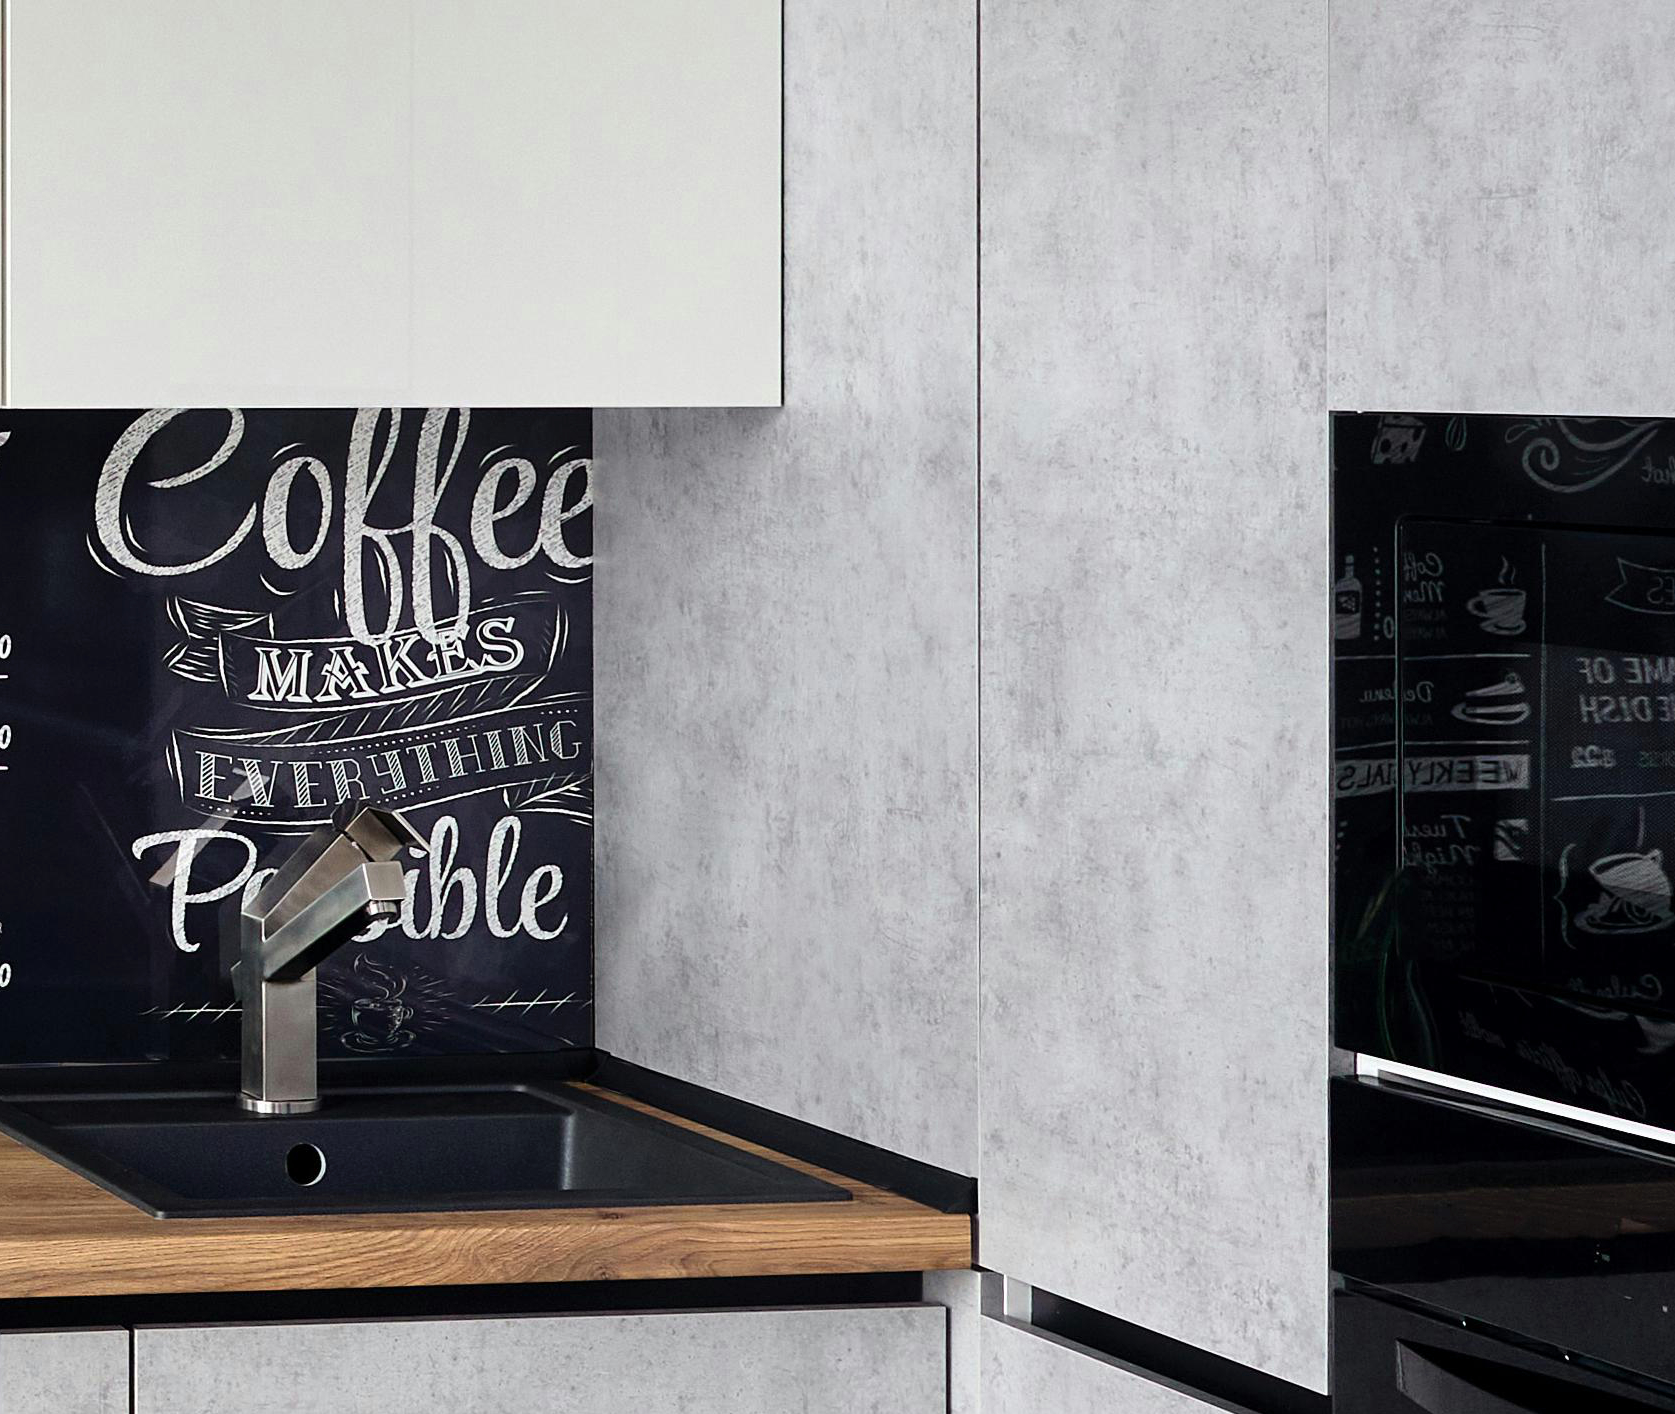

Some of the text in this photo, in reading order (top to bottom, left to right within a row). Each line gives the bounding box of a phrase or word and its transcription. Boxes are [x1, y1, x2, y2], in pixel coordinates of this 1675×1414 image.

[95, 408, 594, 646] Coffee
[247, 617, 526, 703] MAKES
[194, 720, 583, 808] EVERYTHING
[131, 816, 568, 952] Pible
